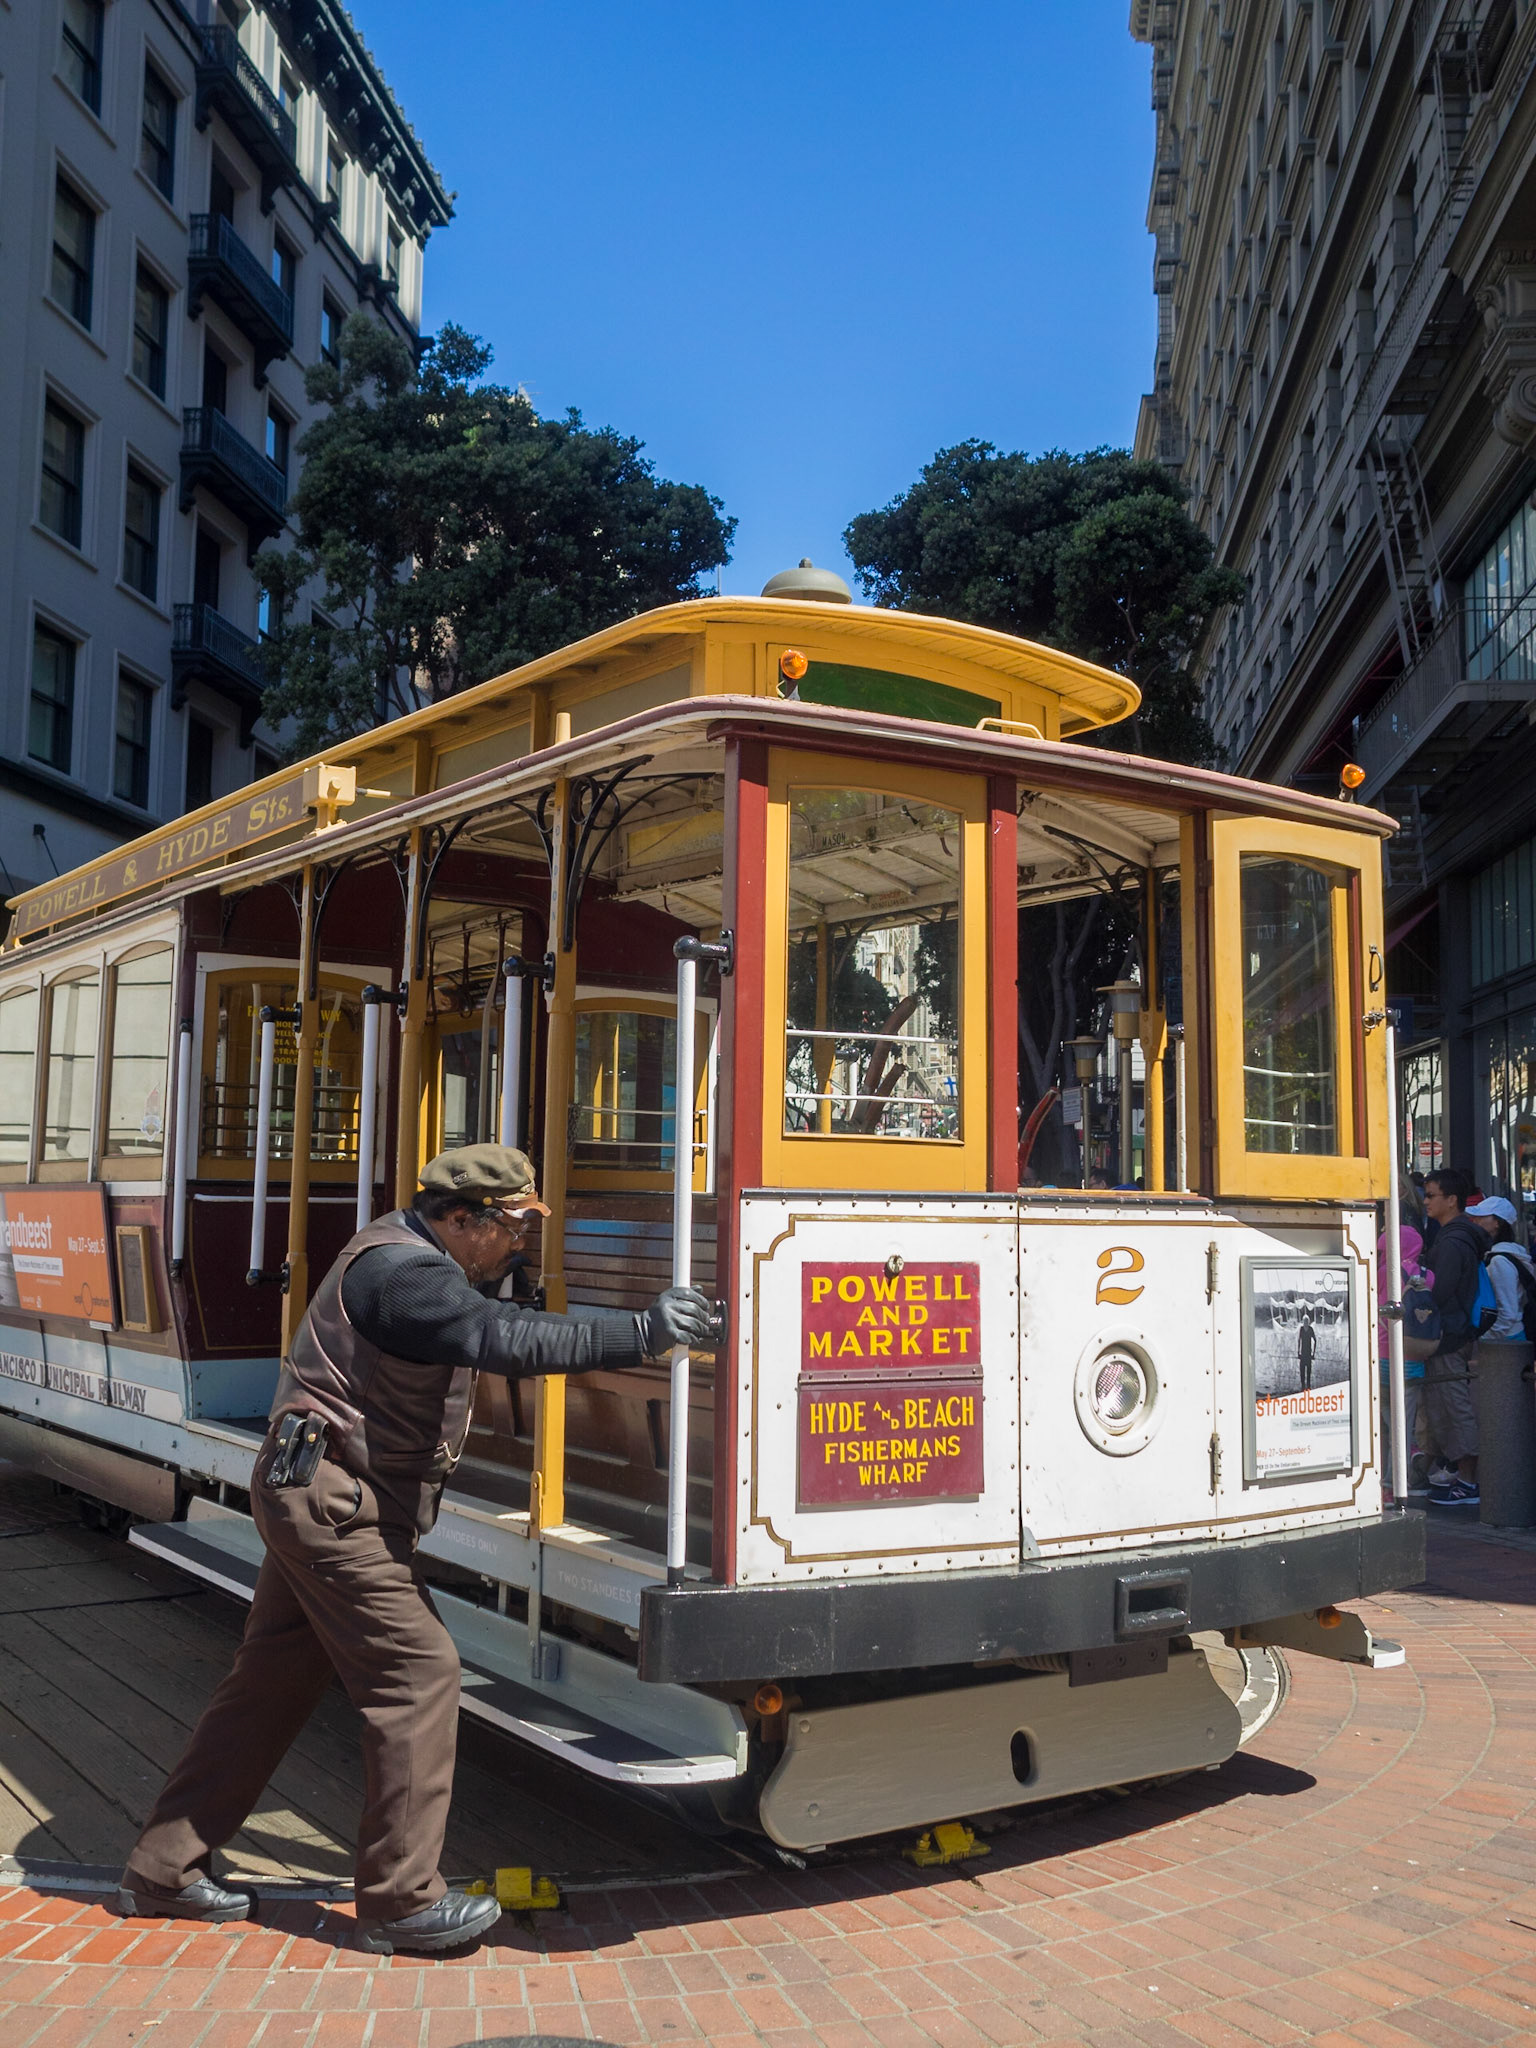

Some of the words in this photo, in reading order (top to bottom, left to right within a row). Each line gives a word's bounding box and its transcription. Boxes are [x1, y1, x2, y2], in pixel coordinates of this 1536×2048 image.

[822, 831, 846, 847] MASON
[26, 877, 107, 926] POWELL
[123, 859, 138, 887] &
[156, 816, 231, 873] HYDE
[247, 794, 293, 835] Sts.
[320, 1009, 341, 1021] WAY
[811, 1274, 972, 1303] POWELL
[1096, 1246, 1145, 1305] 2
[856, 1305, 929, 1327] AND
[809, 1328, 973, 1358] MARKET
[98, 1378, 147, 1413] RAILWAY
[1256, 1388, 1344, 1417] strandbeest
[810, 1401, 867, 1434] HYDE
[873, 1402, 900, 1430] AND
[904, 1396, 974, 1429] BEACH
[825, 1435, 961, 1464] FISHERMANS
[1256, 1449, 1267, 1459] May
[1307, 1445, 1311, 1454] 5
[859, 1461, 929, 1486] WHARF
[437, 1526, 477, 1548] STANDEES
[478, 1538, 498, 1556] ONLY
[558, 1570, 578, 1588] TWO
[580, 1577, 632, 1604] STANDEES
